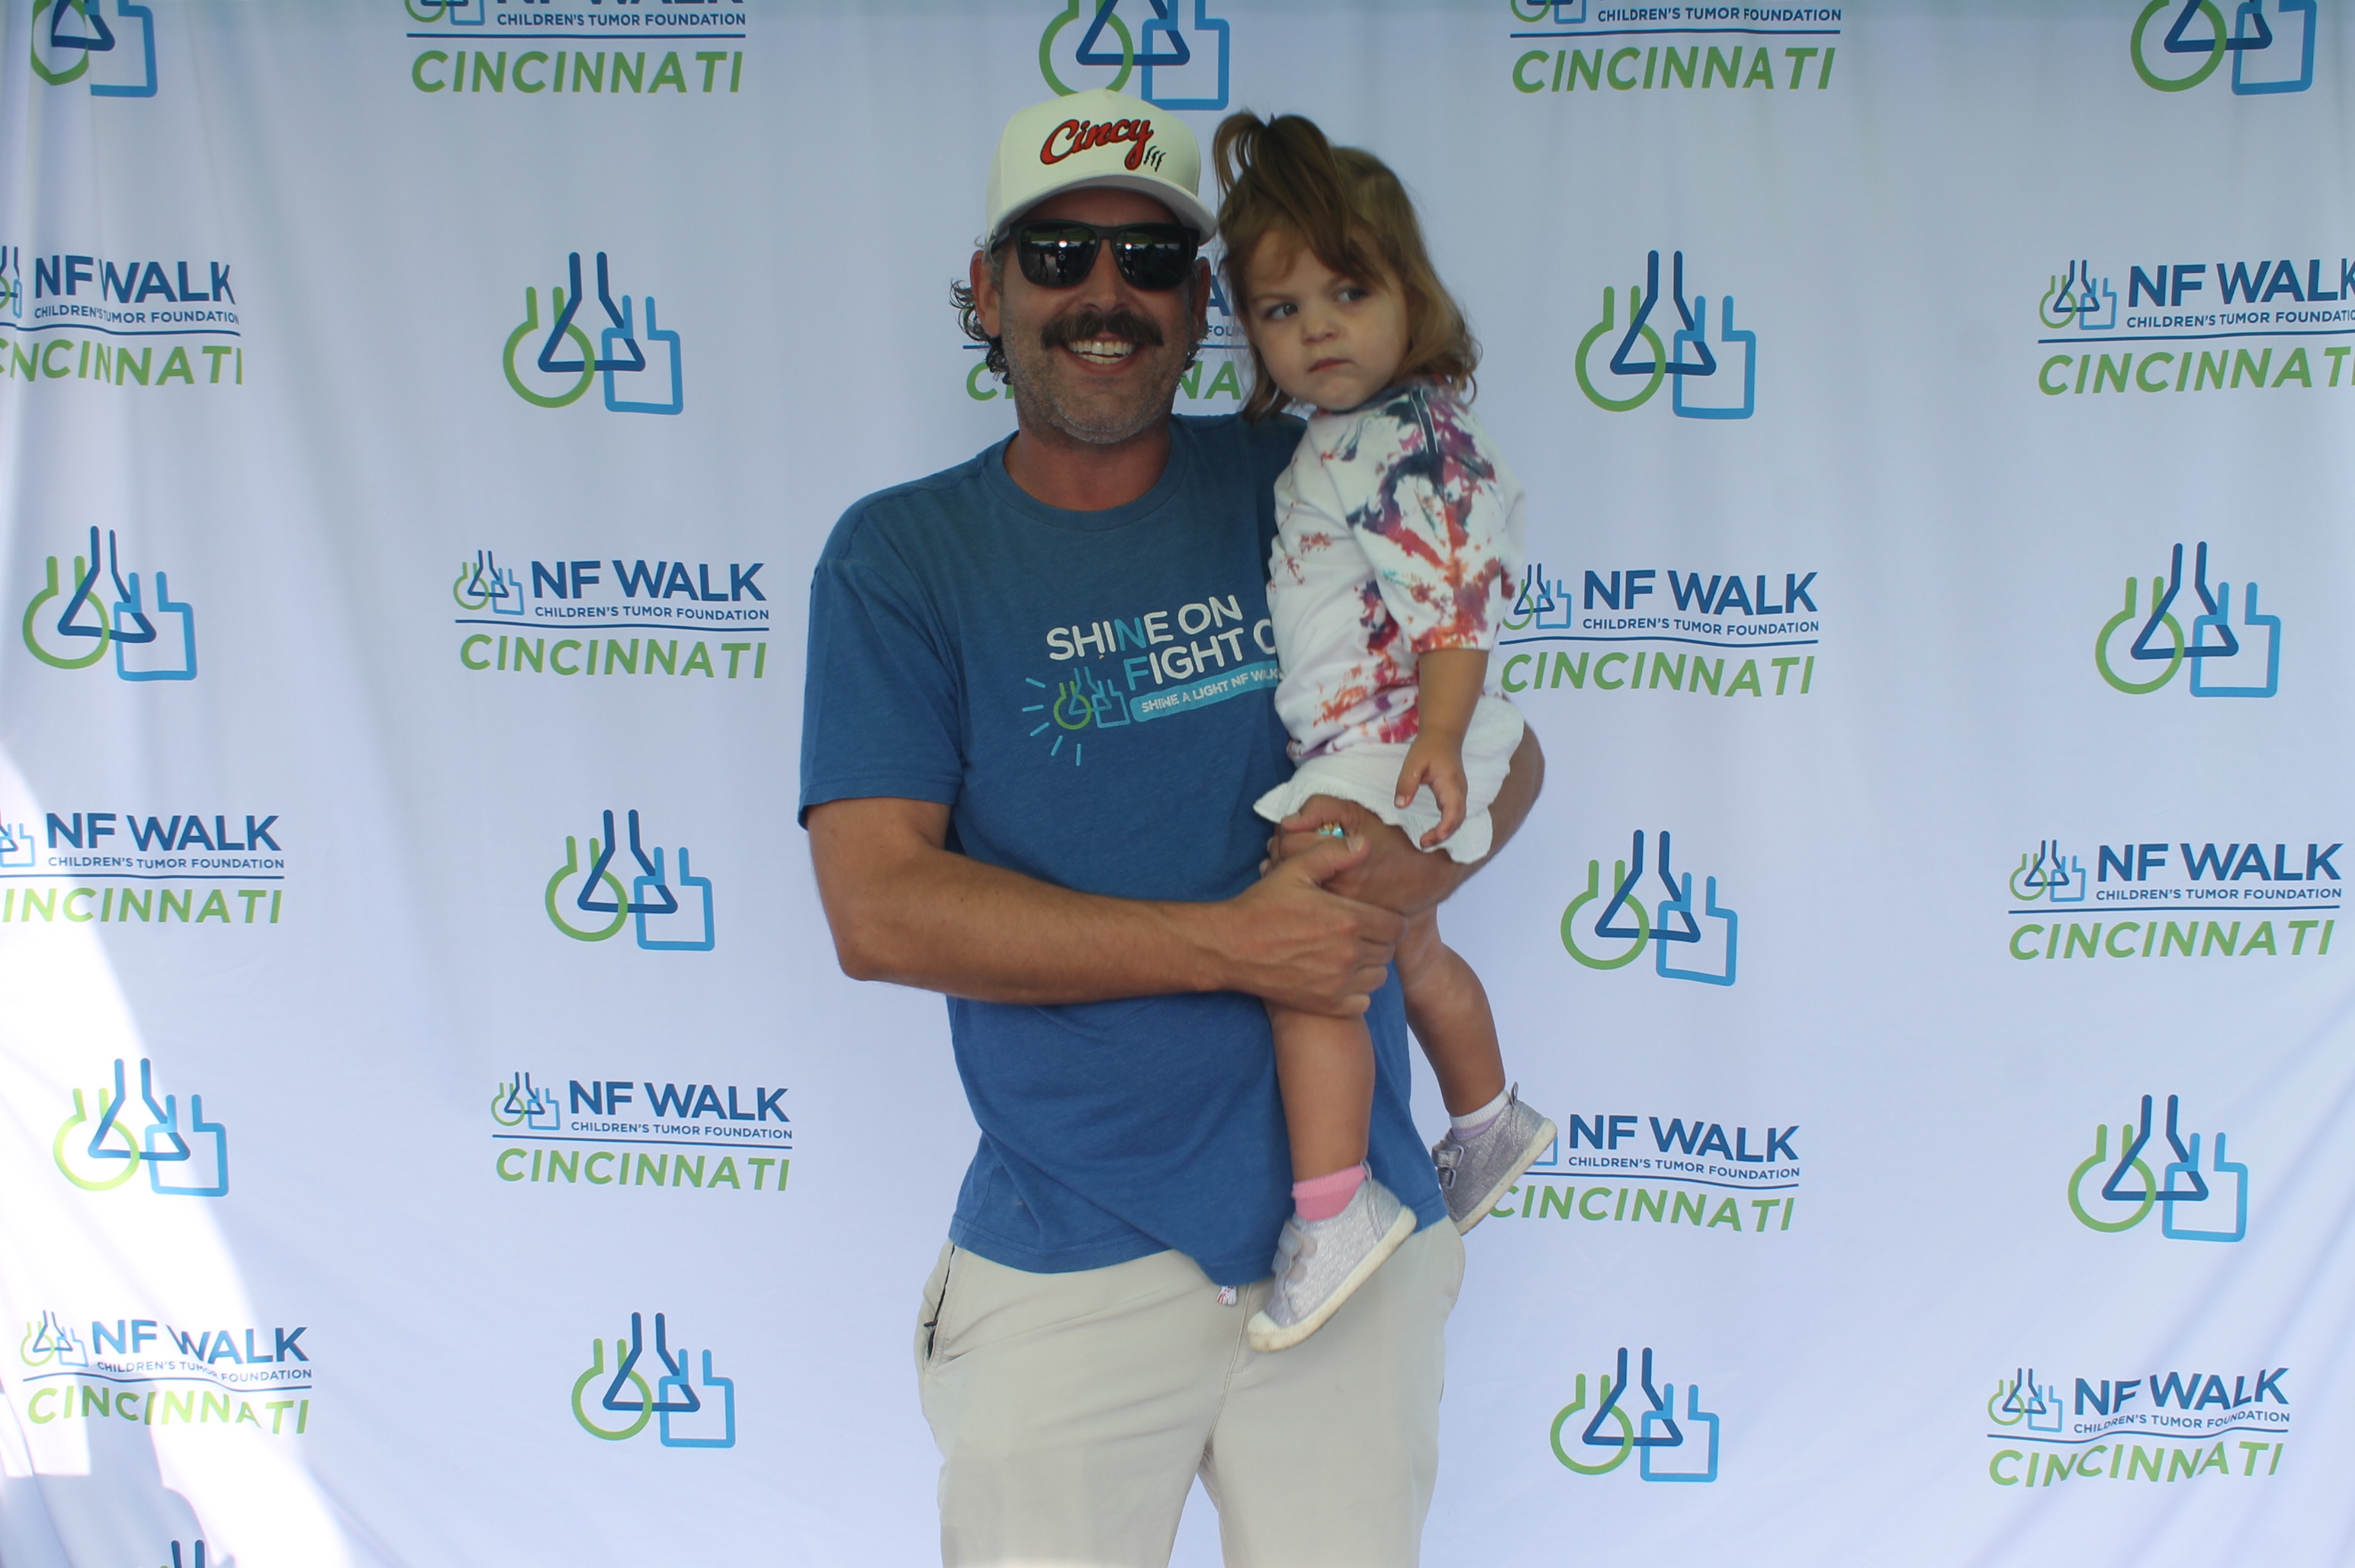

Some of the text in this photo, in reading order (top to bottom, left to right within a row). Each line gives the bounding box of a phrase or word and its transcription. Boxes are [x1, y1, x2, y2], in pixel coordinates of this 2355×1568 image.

[497, 14, 746, 26] CHILDREN'S TUMOR FOUNDATION
[1598, 8, 1842, 22] CHILDREN'S TUMOR FOUNDATION
[412, 50, 743, 93] CINCINNATI
[1512, 46, 1836, 93] CINCINNATI
[1040, 119, 1154, 171] Cincy
[36, 255, 236, 304] NF WALK
[2128, 258, 2355, 307] NF WALK
[35, 305, 239, 324] CHILDREN'S TUMOR FOUNDATION
[2127, 315, 2215, 328] CHILDREN'S
[2220, 313, 2270, 326] TUMOR
[532, 560, 767, 602] NF WALK
[1584, 570, 1818, 615] NF WALK
[535, 607, 769, 620] CHILDREN'S TUMOR FOUNDATION
[1046, 595, 1243, 660] SHINE ON
[1583, 619, 1819, 635] CHILDREN'S TUMOR FOUNDATION
[460, 634, 766, 679] CINCINNATI
[1123, 628, 1244, 690] FIGHT
[1501, 651, 1815, 697] CINCINNATI
[1142, 694, 1179, 712] SHINE
[1183, 692, 1190, 702] A
[1192, 680, 1228, 700] LIGHT
[1231, 673, 1248, 688] NF
[47, 813, 282, 851] NF WALK
[48, 856, 284, 869] CHILDREN'S TUMOR FOUNDATION
[2098, 843, 2344, 882] NF WALK
[2, 888, 282, 924] INCINNATI
[2096, 888, 2341, 901] CHILDREN'S TUMOR FOUNDATION
[2009, 920, 2335, 960] CINCINNATI
[570, 1080, 790, 1123] NF WALK
[571, 1122, 792, 1139] CHILDREN'S TUMOR FOUNDATION
[1569, 1113, 1800, 1162] NF WALK
[496, 1148, 790, 1191] CINCINNATI
[1569, 1156, 1800, 1180] CHILDREN'S TUMOR FOUNDATION
[92, 1319, 310, 1364] NF WALK
[97, 1361, 312, 1382] CHILDREN'S TUMOR FOUNDATION
[2075, 1367, 2289, 1415] NF WALK
[27, 1385, 310, 1435] CINCINNATI
[2074, 1410, 2289, 1434] CHILDREN'S TUMOR FOUNDATION
[1989, 1441, 2284, 1488] CINCINNATI
